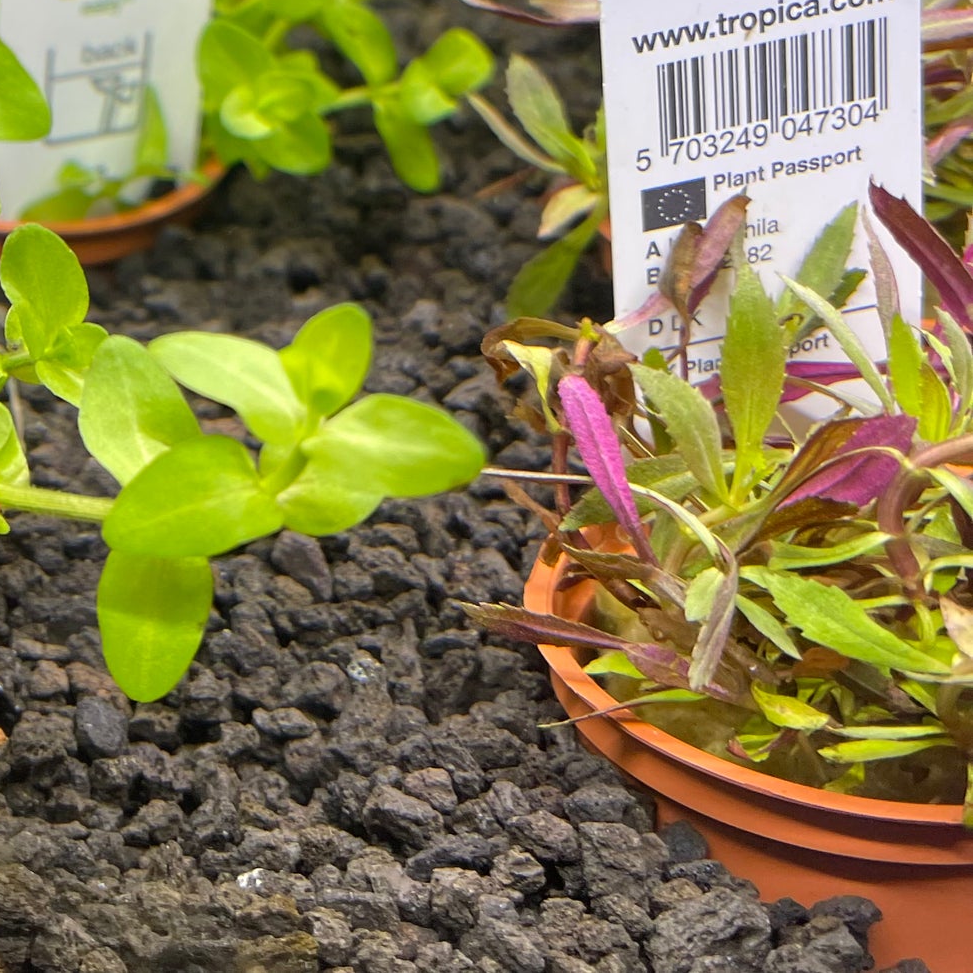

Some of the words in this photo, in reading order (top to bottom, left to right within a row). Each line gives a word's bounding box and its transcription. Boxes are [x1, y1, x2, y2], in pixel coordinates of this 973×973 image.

[636, 148, 652, 172] 5
[669, 124, 767, 165] 703249
[781, 99, 879, 141] 047304
[713, 166, 765, 191] Plant
[771, 145, 862, 180] Passport
[646, 241, 661, 259] A
[747, 244, 772, 264] 82
[649, 319, 663, 336] D
[789, 334, 828, 358] port
